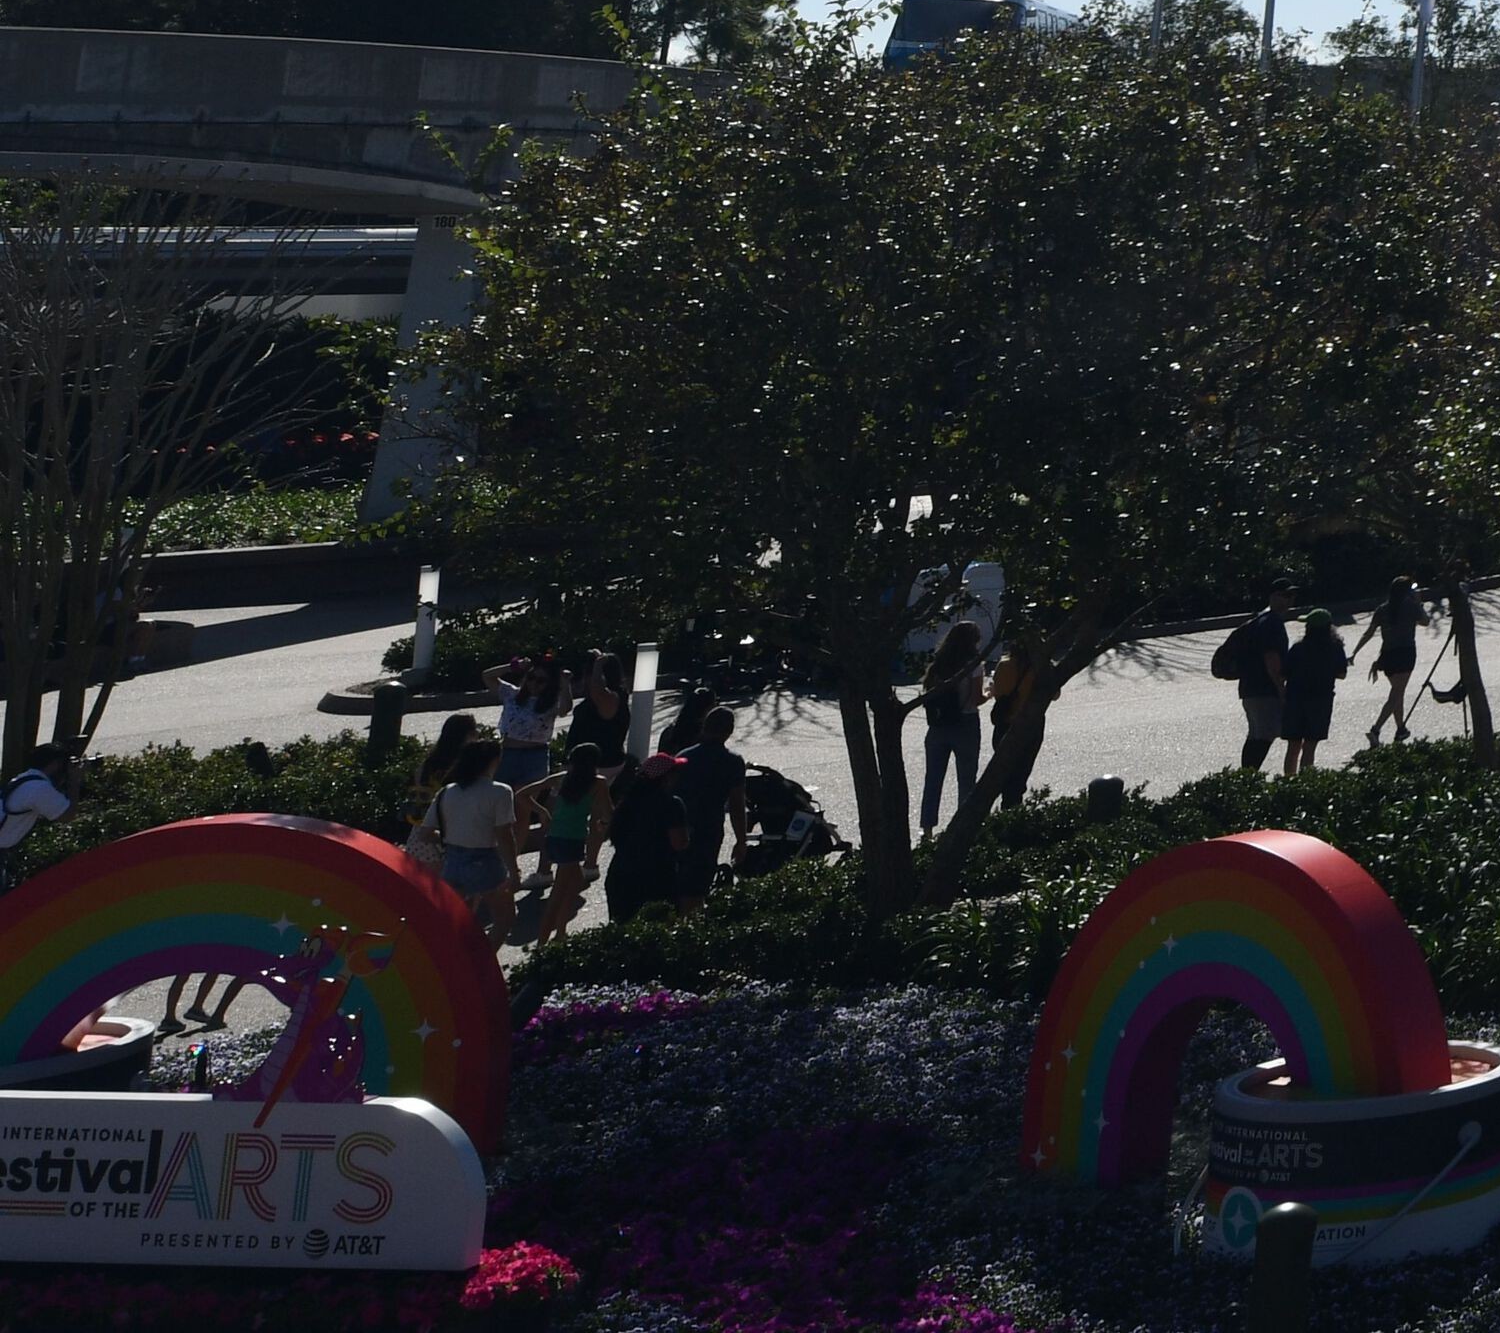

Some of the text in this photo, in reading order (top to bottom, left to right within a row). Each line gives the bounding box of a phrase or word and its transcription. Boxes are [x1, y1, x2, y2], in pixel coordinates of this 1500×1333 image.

[433, 216, 457, 228] 180
[3, 1127, 146, 1142] INTERNATIONAL
[1224, 1125, 1310, 1142] INTERNATIONAL
[1256, 1142, 1324, 1169] ARTS
[0, 1130, 396, 1224] stival ARTS
[70, 1202, 140, 1219] OF THE
[1315, 1224, 1367, 1242] ATION
[141, 1233, 386, 1256] PRESENTED BY AT&T
